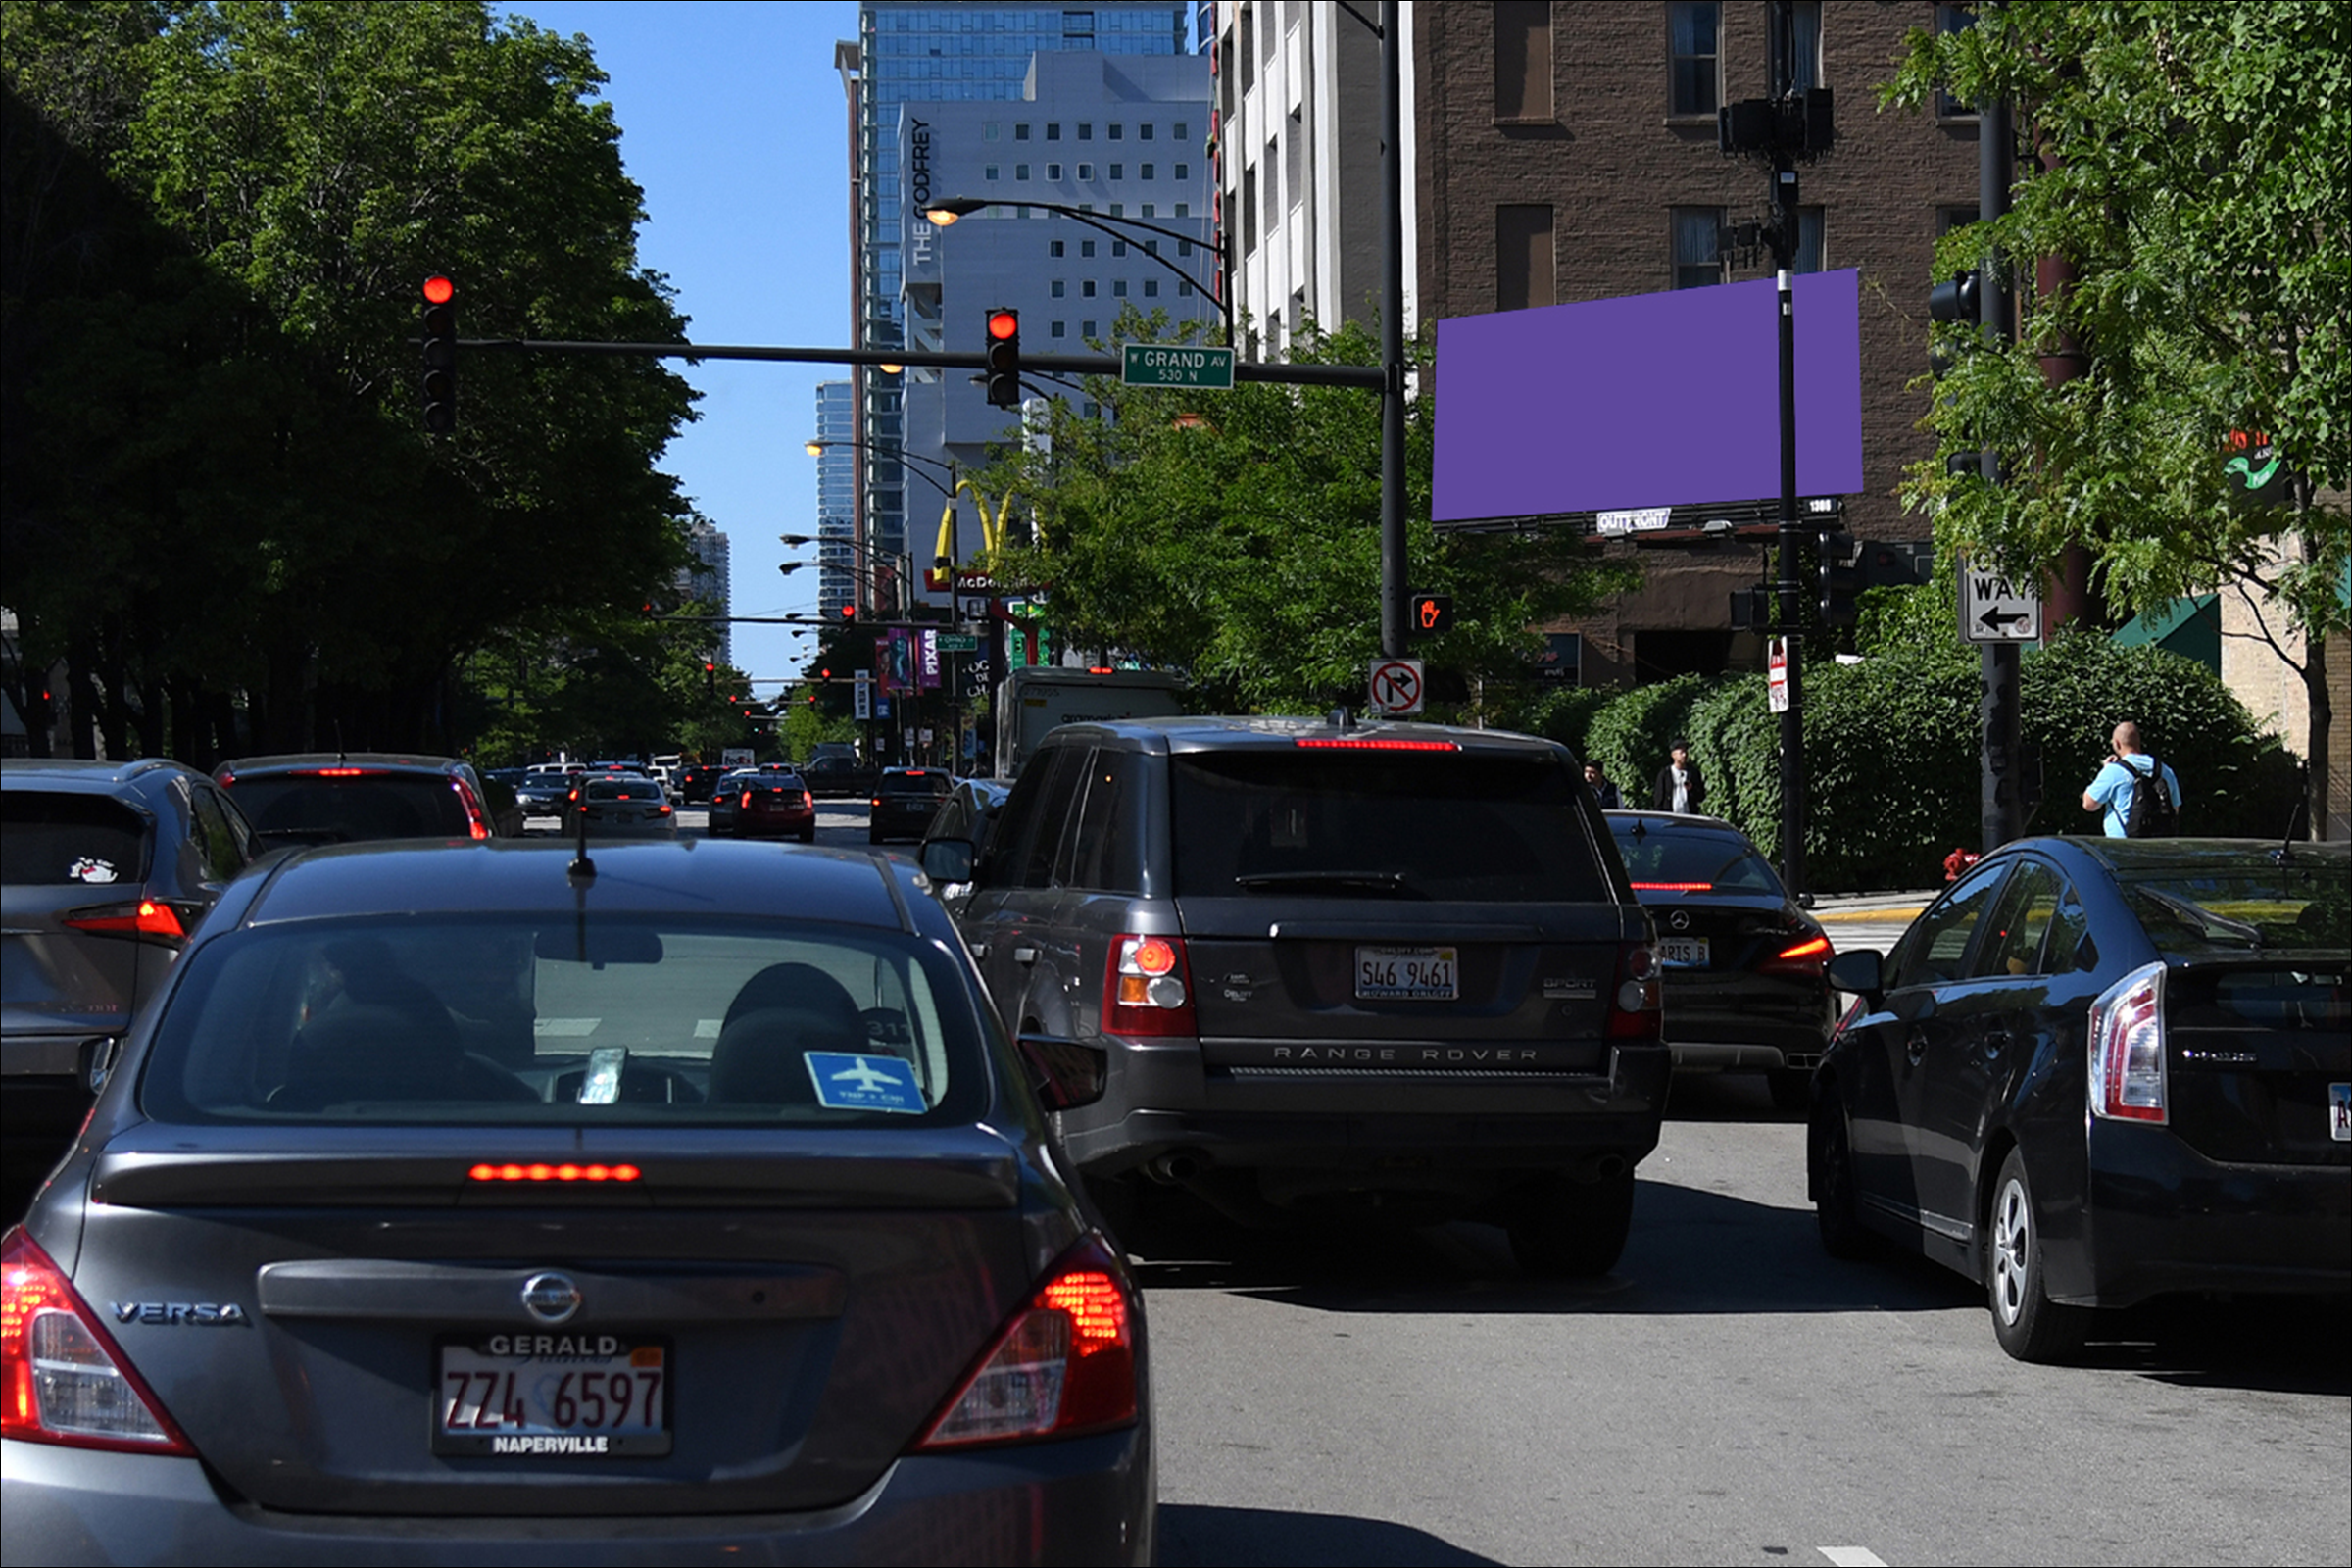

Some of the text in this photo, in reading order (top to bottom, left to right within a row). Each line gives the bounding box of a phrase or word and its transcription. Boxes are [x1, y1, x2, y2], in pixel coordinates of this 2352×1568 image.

[911, 117, 932, 266] THE GODFREY
[1130, 350, 1226, 368] W GRAND AV
[1158, 368, 1198, 382] 530 N
[1974, 578, 2032, 601] WAY
[924, 628, 939, 676] PIXAR
[1698, 945, 1706, 962] B
[1362, 961, 1453, 988] S46 9461
[1274, 1047, 1537, 1061] RANGE ROVER
[110, 1301, 244, 1323] VERSA
[490, 1335, 618, 1356] GERALD
[447, 1372, 662, 1429] ZZ4 6597
[493, 1435, 609, 1454] NAPERVILLE
